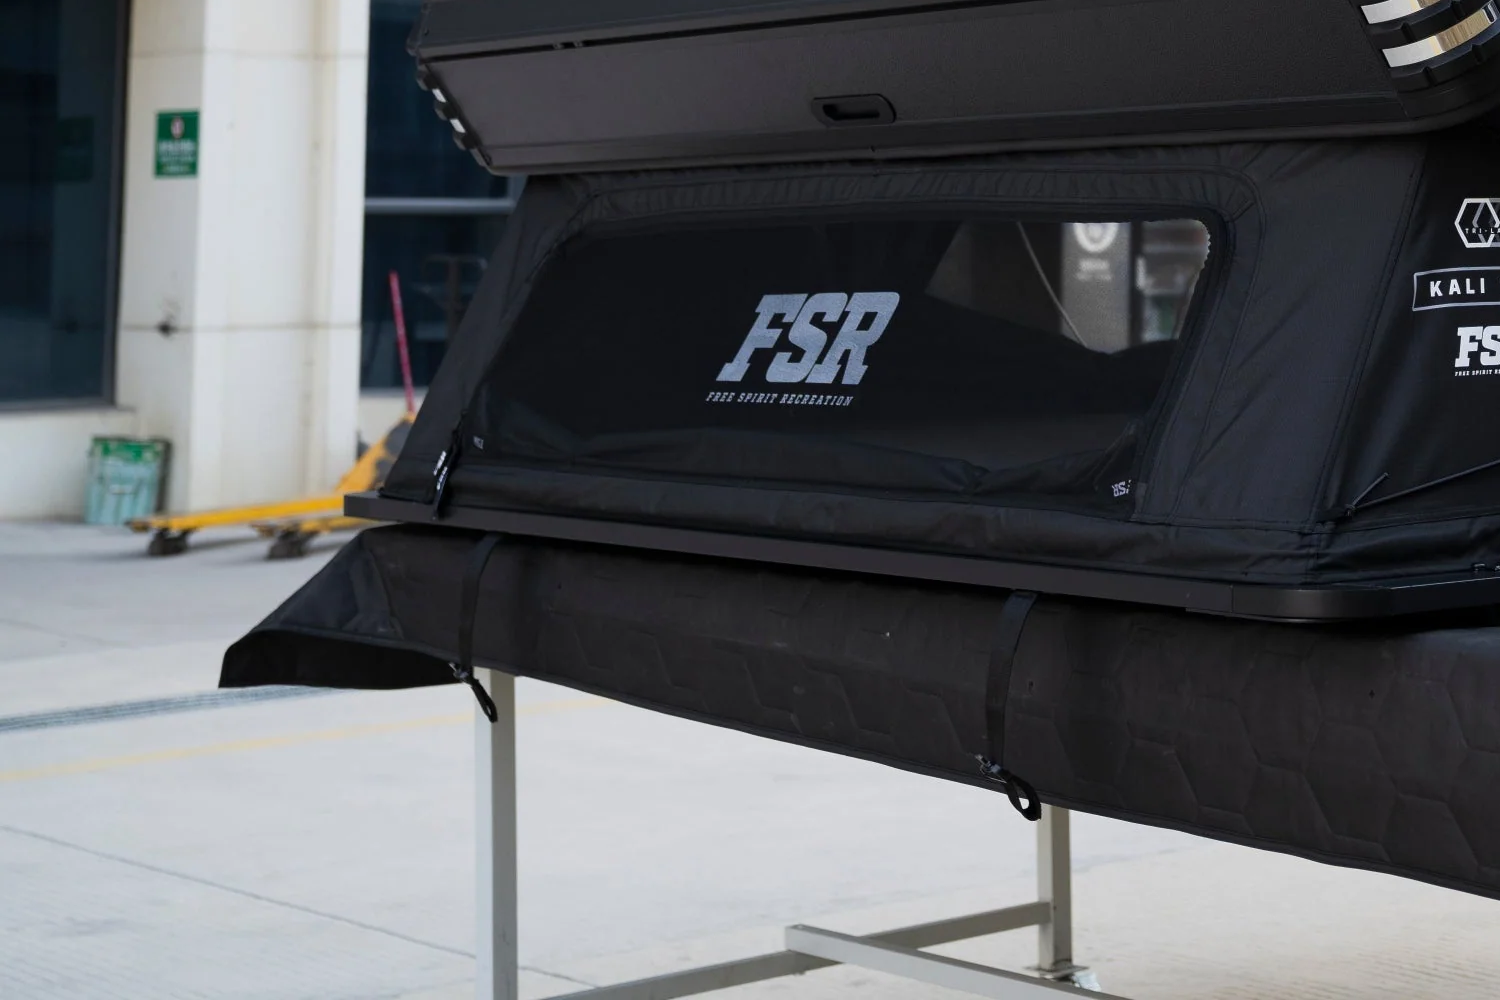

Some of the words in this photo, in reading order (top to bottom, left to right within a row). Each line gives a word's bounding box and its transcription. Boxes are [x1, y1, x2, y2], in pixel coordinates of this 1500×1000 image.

[1429, 277, 1486, 298] KALI
[715, 291, 901, 385] FSR
[705, 391, 736, 403] FREE
[737, 392, 778, 404] SPIRIT
[779, 393, 854, 407] RECREATION
